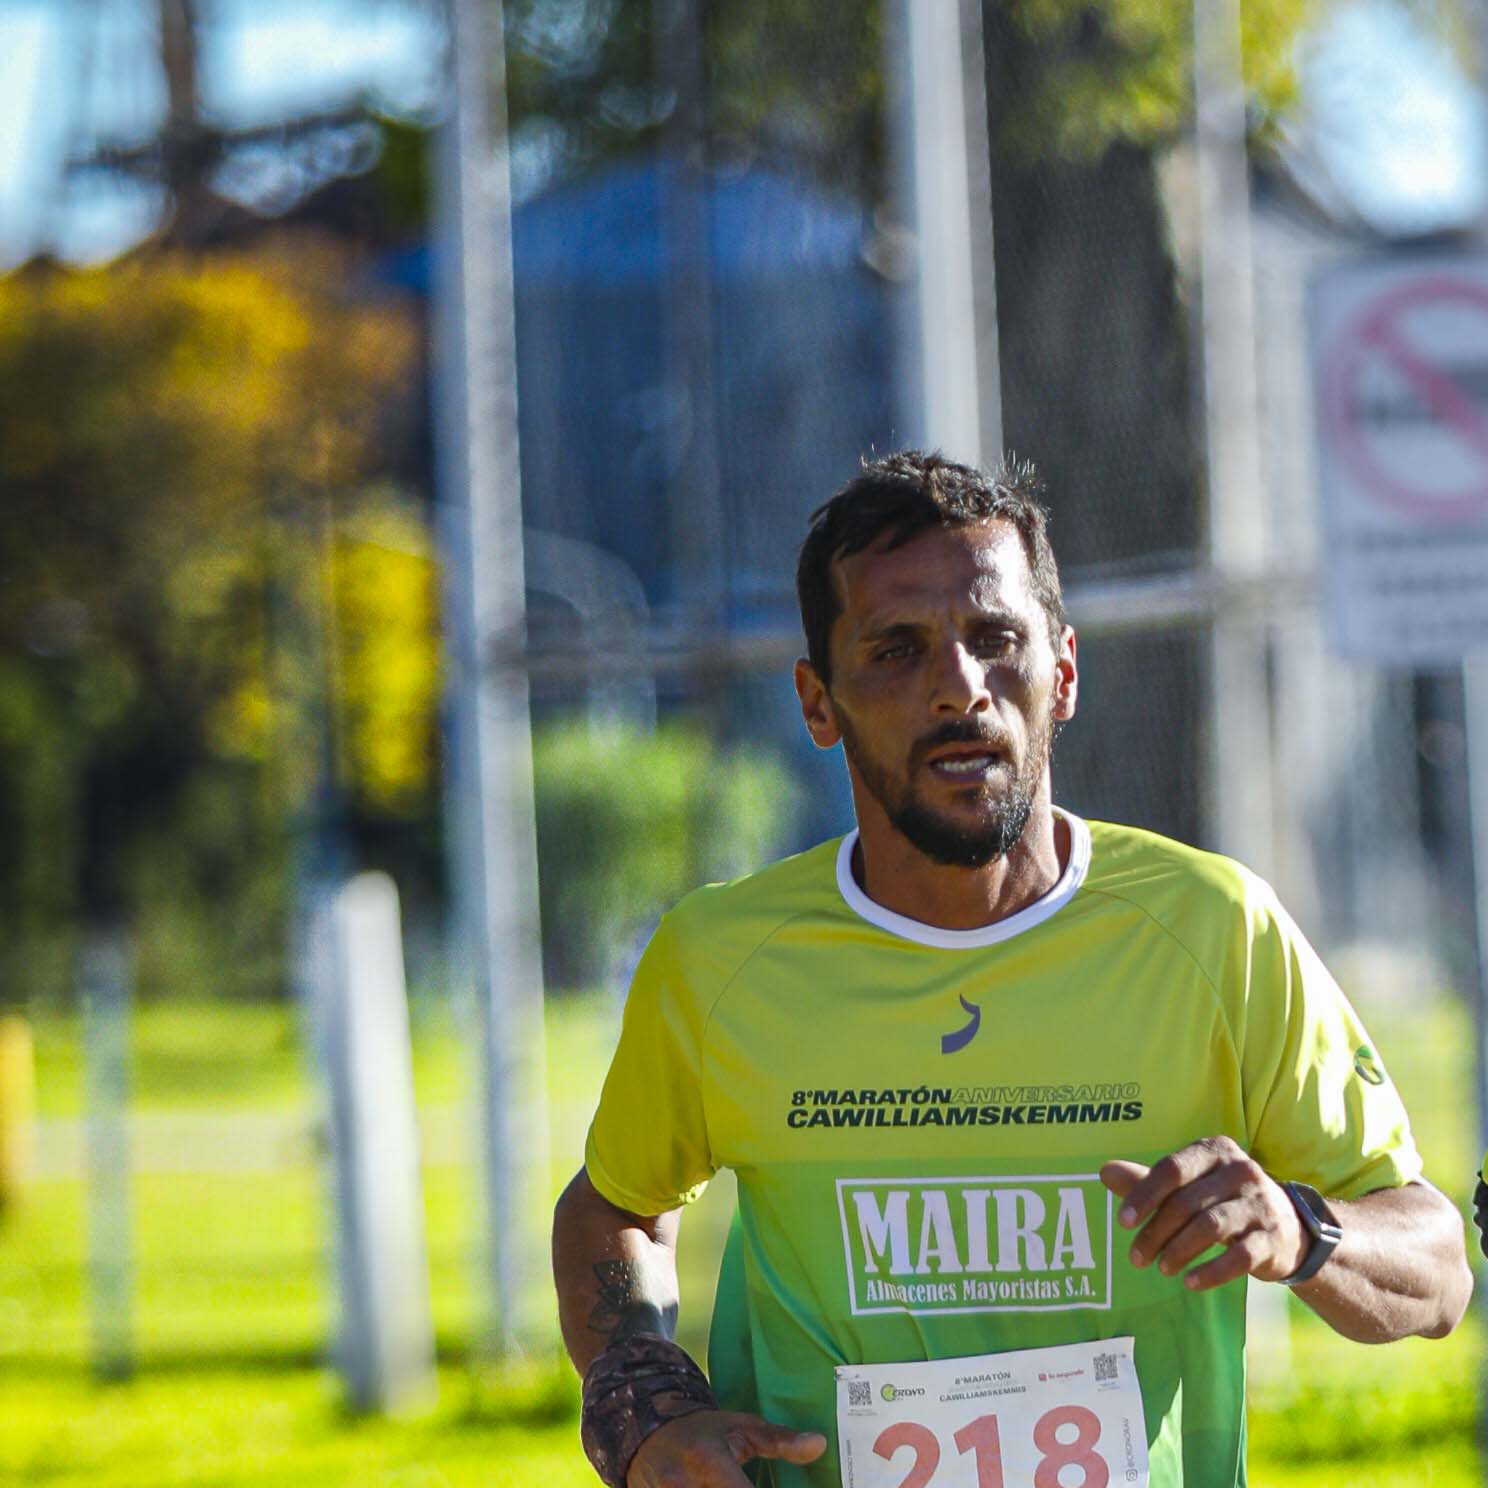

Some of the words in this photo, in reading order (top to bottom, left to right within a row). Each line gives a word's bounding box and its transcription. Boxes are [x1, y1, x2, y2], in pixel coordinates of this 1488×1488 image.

[952, 1082, 1141, 1104] ANIVERSARIO
[787, 1101, 1143, 1128] CAWILLIAMSKEMMIS
[852, 1187, 1096, 1275] MAIRA
[866, 1279, 957, 1303] Almacenes
[962, 1276, 1060, 1303] Mayoristas
[1065, 1275, 1096, 1297] S.A.
